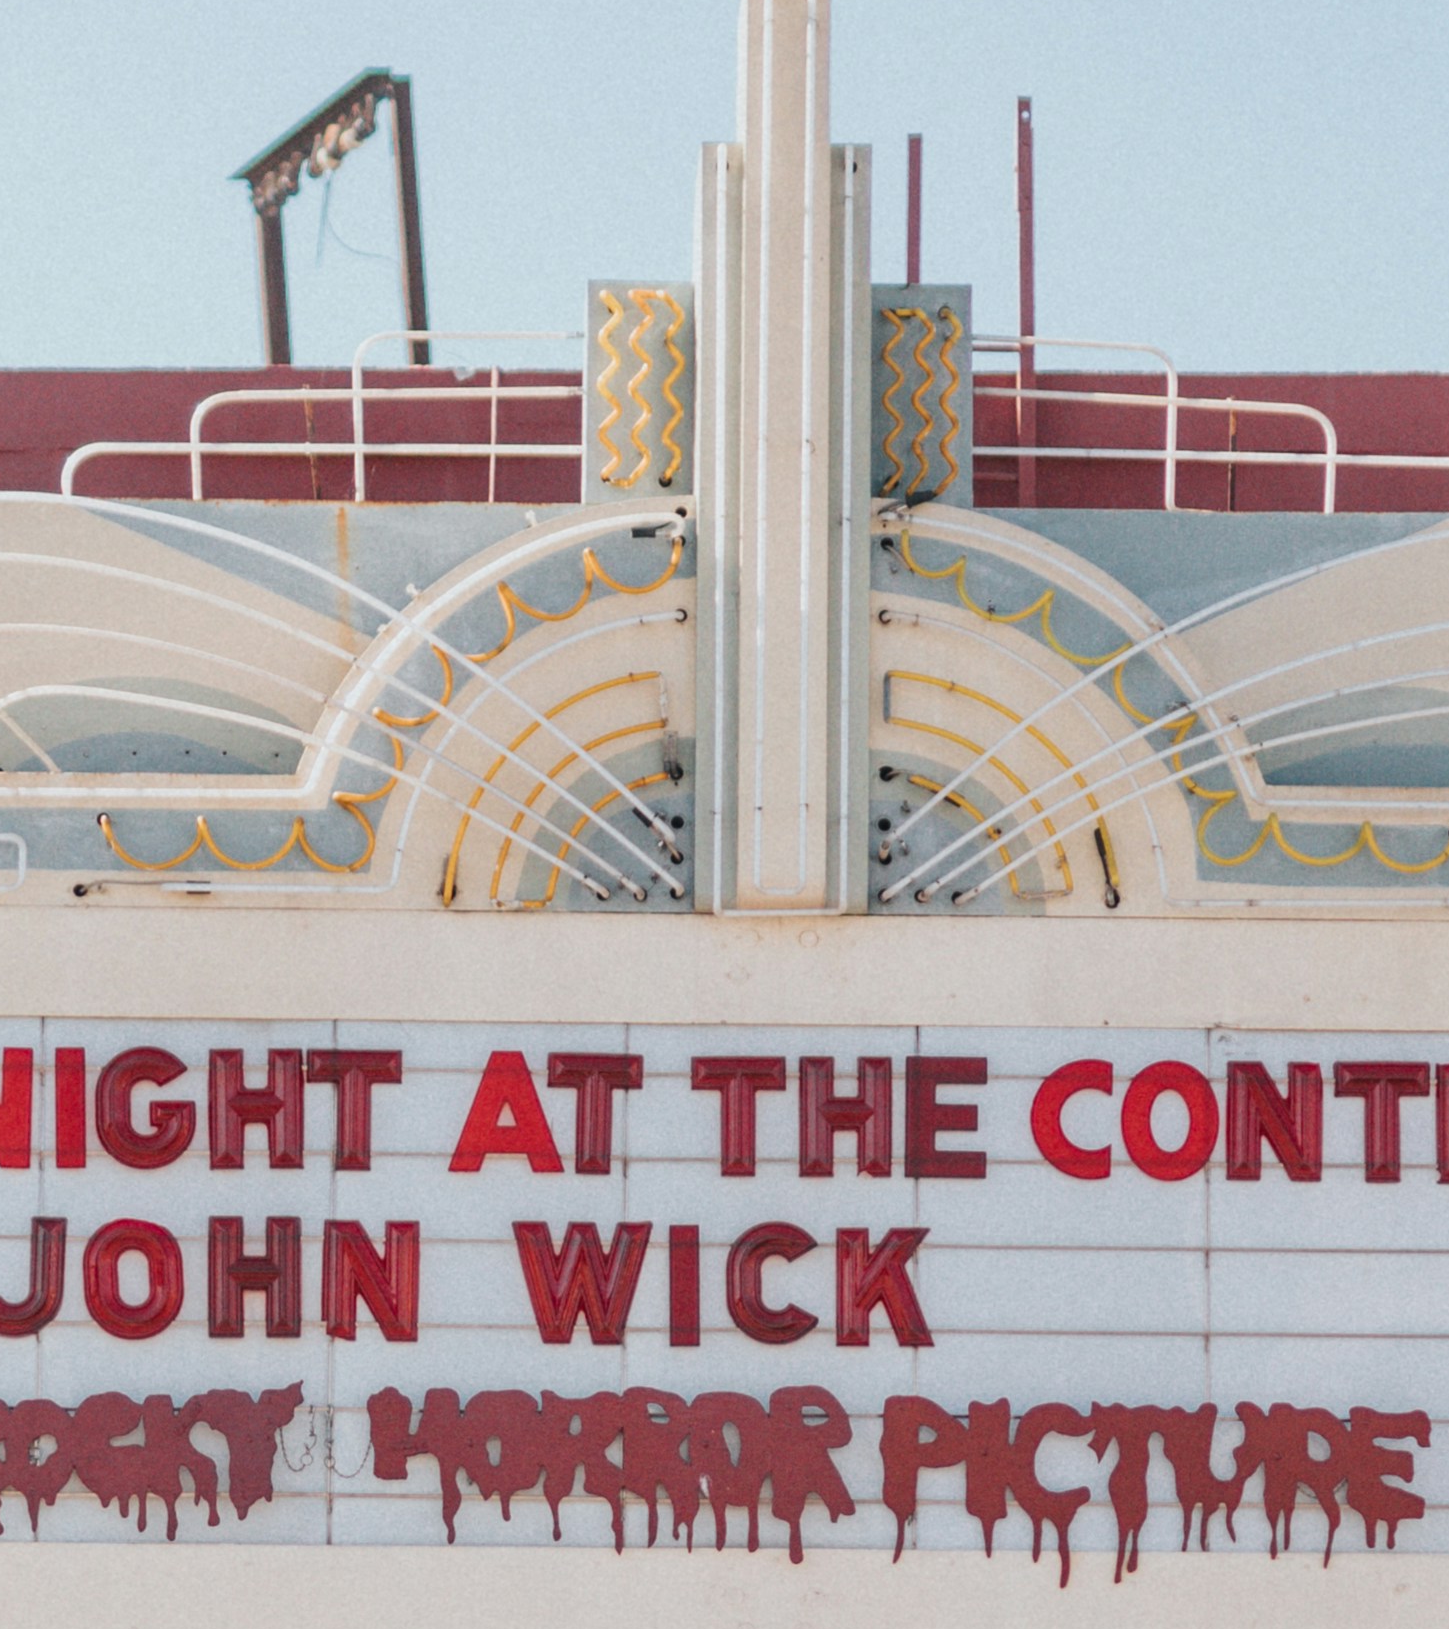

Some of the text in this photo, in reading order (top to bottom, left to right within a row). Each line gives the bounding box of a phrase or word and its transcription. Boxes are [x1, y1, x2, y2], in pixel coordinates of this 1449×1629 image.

[448, 1050, 644, 1176] AT
[691, 1056, 987, 1179] THE
[512, 1221, 935, 1347] WICK
[366, 1385, 856, 1564] HORROR
[879, 1395, 1432, 1588] PICTURE
